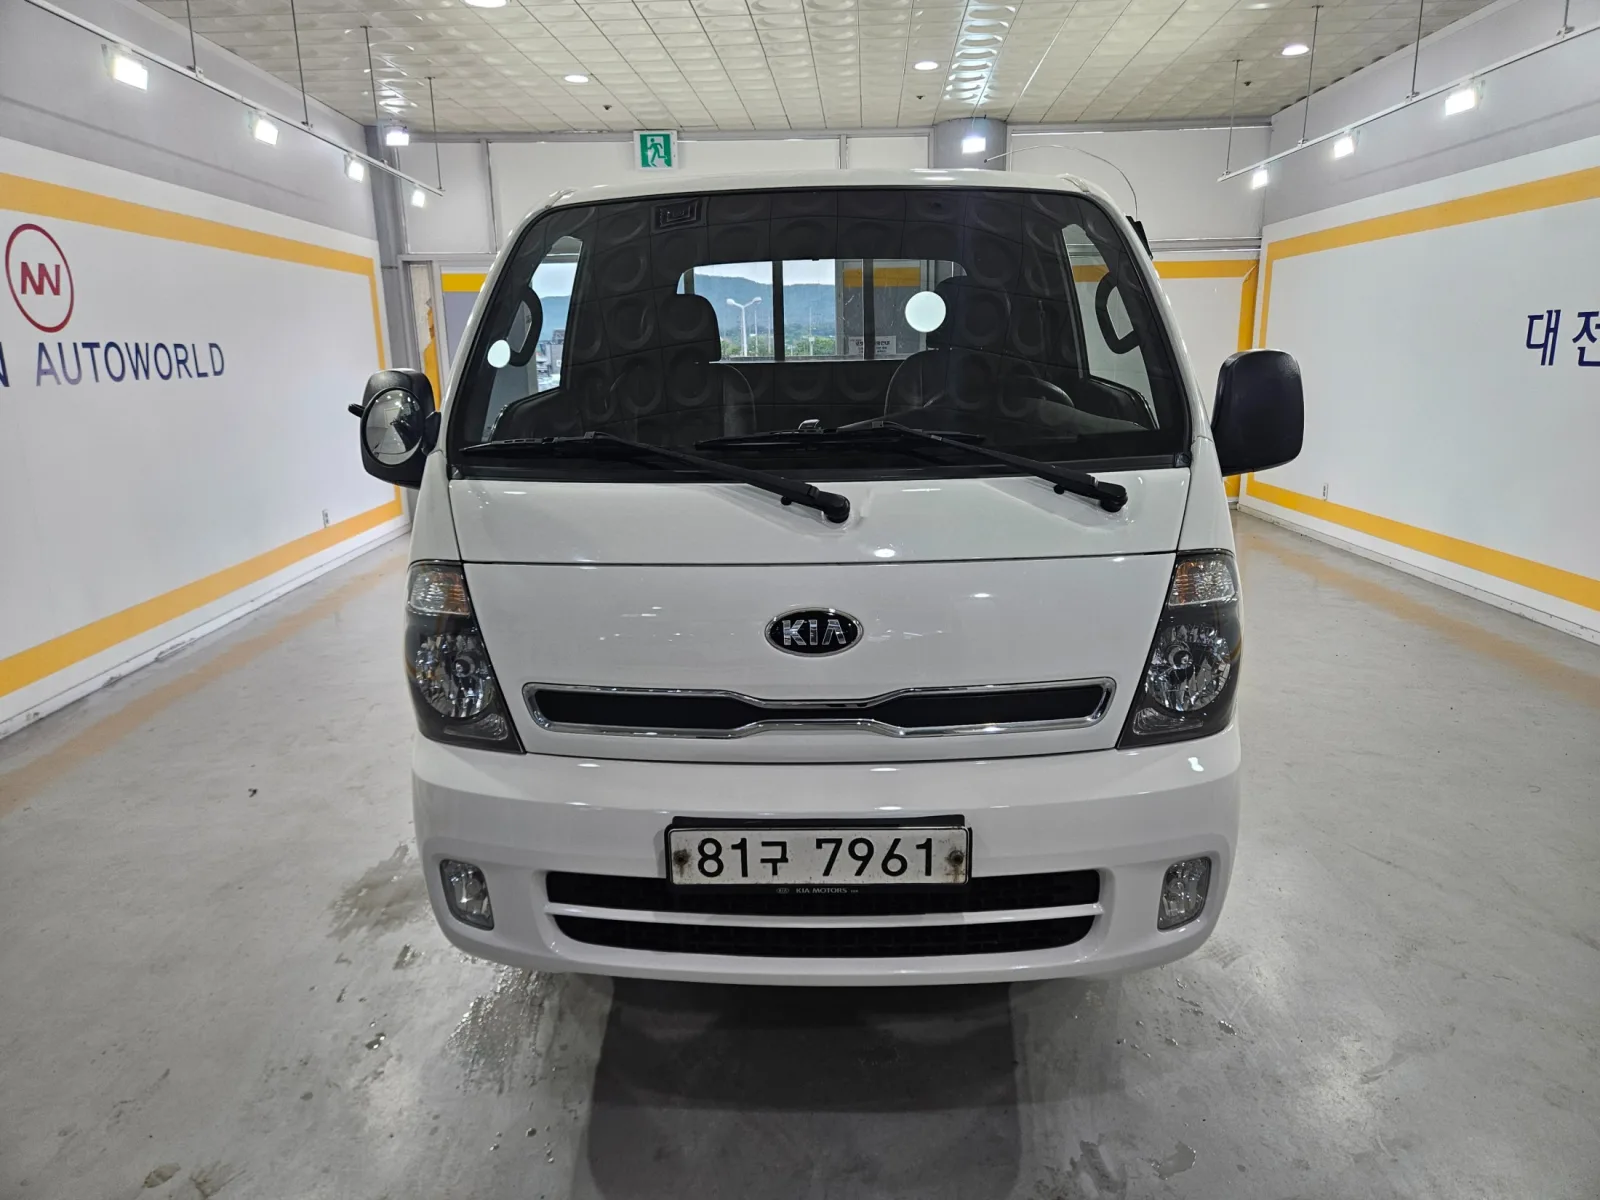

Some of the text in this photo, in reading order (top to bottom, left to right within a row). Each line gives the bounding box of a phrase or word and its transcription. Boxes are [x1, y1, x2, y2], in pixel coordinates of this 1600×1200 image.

[36, 341, 225, 387] AUTOWORLD
[782, 619, 847, 645] KIA
[697, 837, 933, 878] 81구 7961
